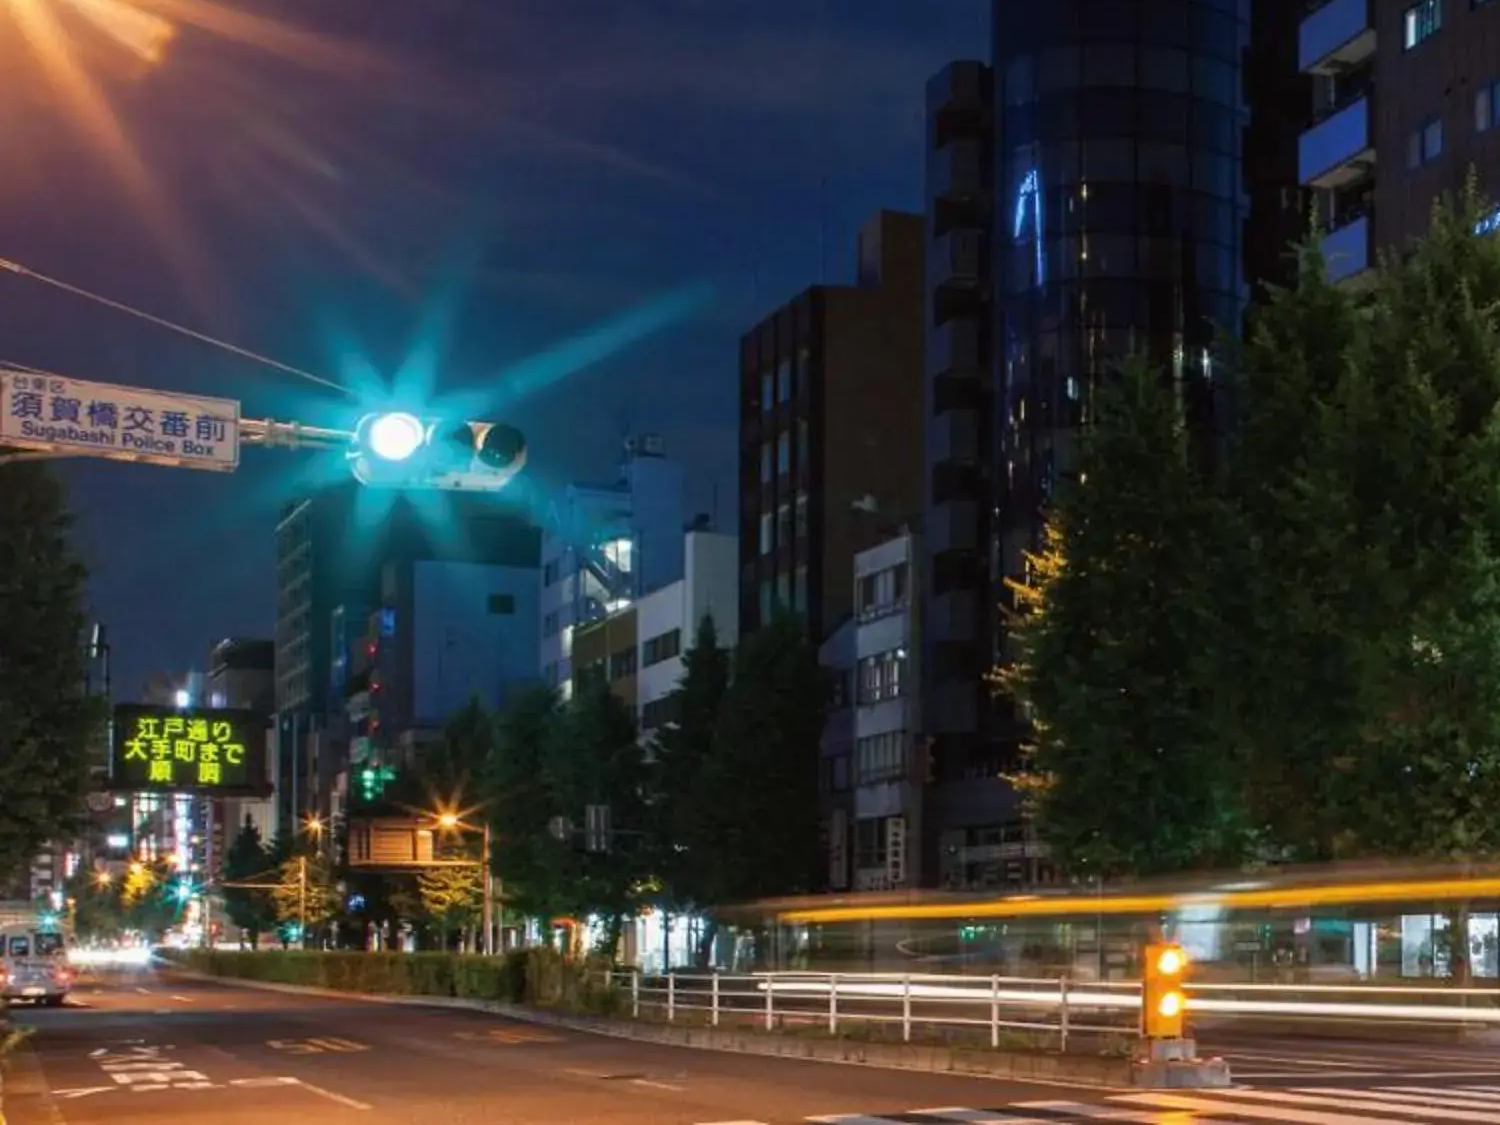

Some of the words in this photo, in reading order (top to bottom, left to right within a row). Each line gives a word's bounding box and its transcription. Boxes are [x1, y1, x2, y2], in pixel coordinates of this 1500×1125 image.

[11, 391, 225, 442] 須賀橋交番前
[21, 420, 115, 445] Sugabashi
[122, 433, 175, 453] Police
[182, 439, 215, 456] Box
[138, 718, 232, 742] 江戸通り
[124, 738, 245, 764] 大手町まで
